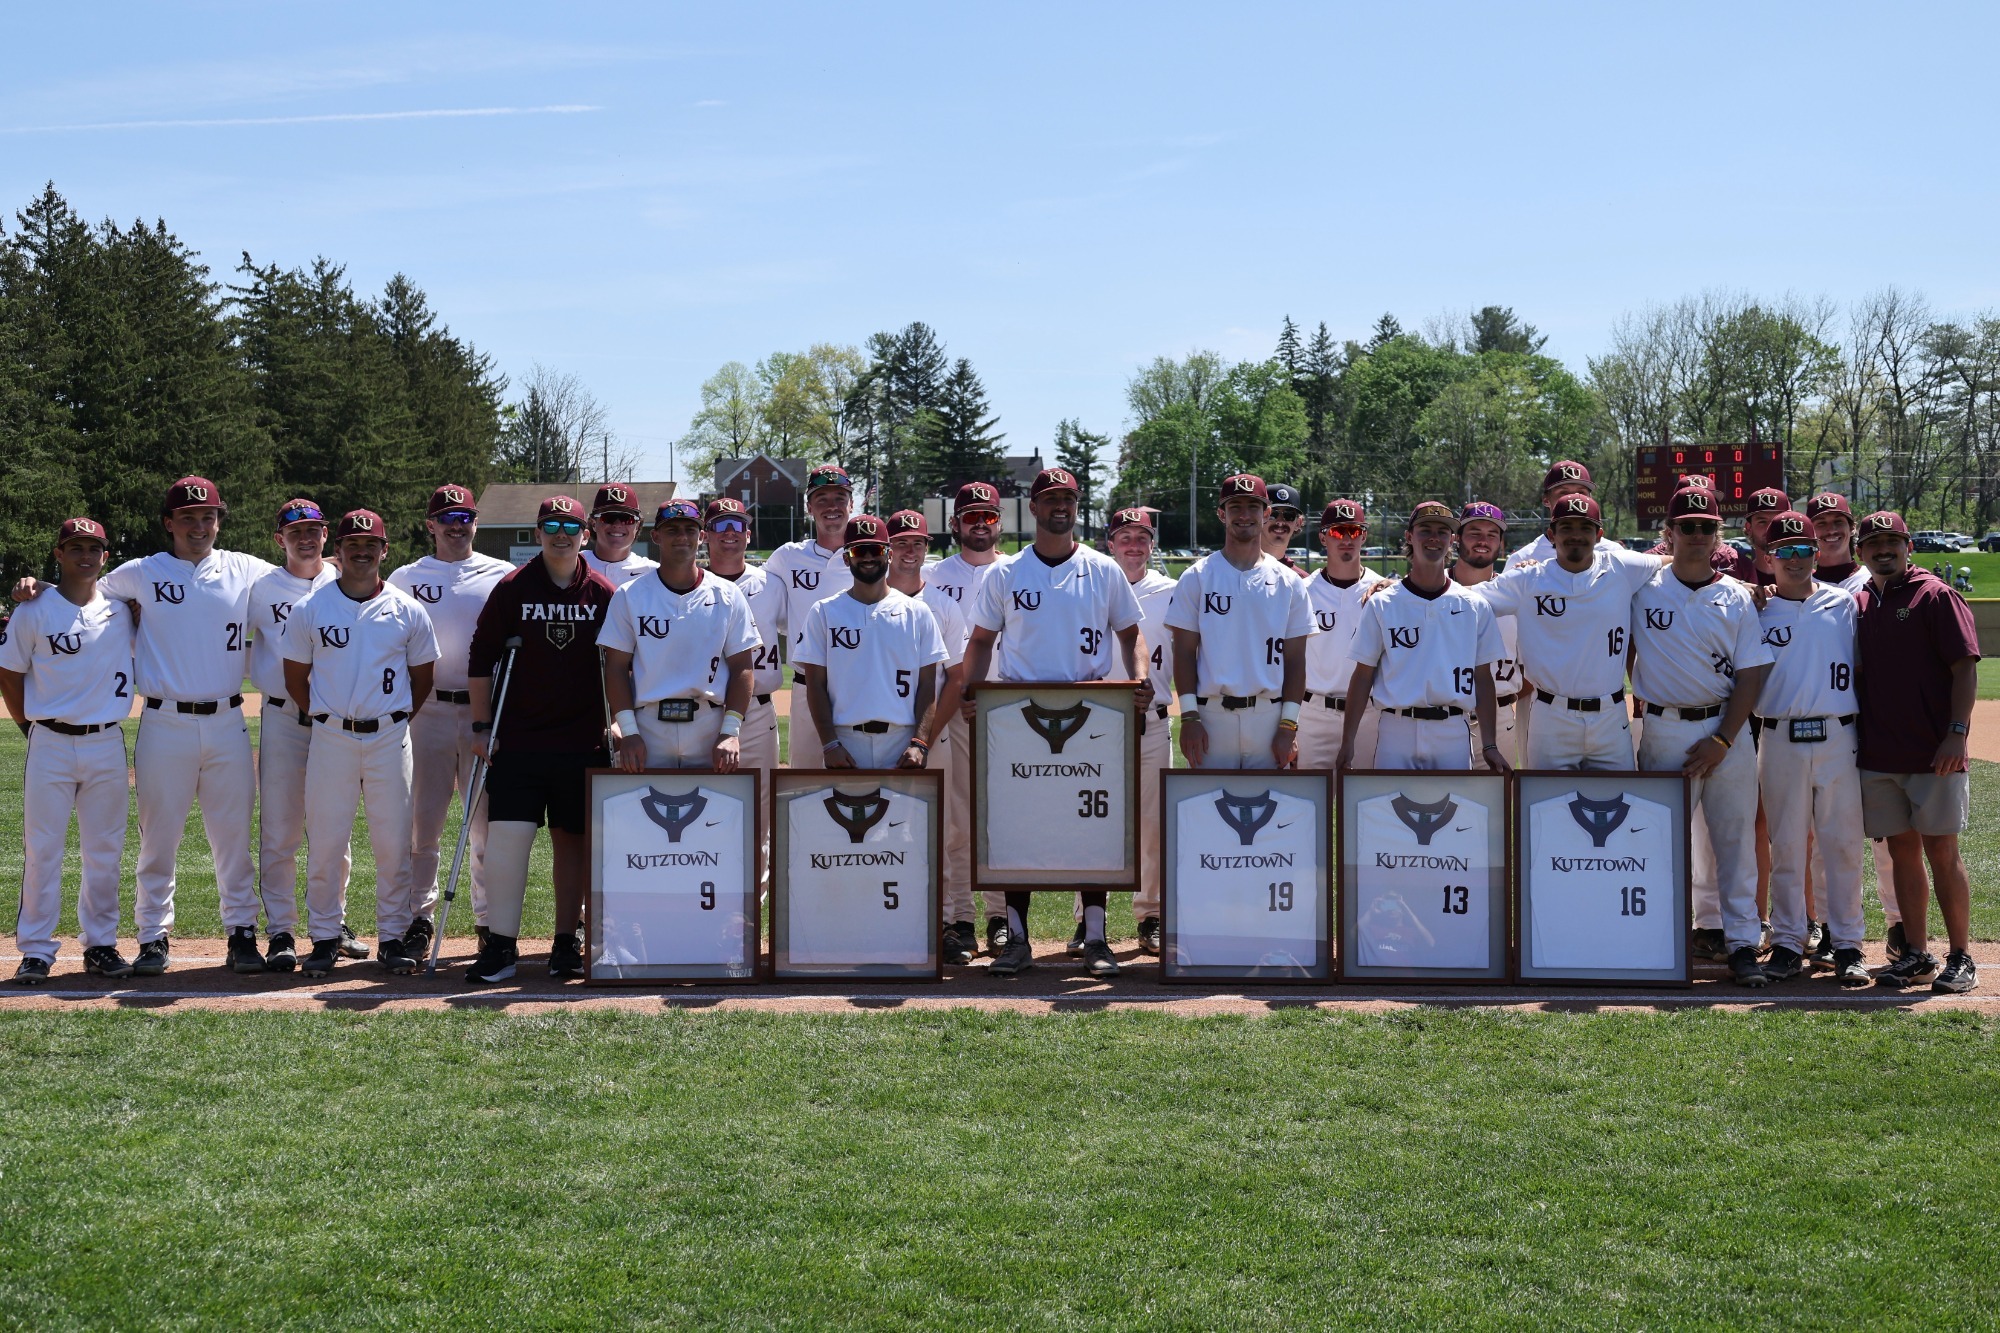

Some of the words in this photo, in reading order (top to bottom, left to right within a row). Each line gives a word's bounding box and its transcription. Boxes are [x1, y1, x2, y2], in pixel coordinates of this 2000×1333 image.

[1676, 453, 1683, 463] 0
[1705, 452, 1712, 462] 0
[1735, 450, 1742, 461] 0
[1048, 470, 1069, 484] KU
[1560, 466, 1581, 480] KU
[1736, 472, 1742, 483] 0
[1234, 478, 1256, 492] KU
[1687, 477, 1708, 488] KU
[184, 485, 208, 500] KU
[443, 490, 464, 504] KU
[606, 488, 628, 502] KU
[971, 488, 992, 501] KU
[1736, 488, 1742, 498] 0
[1757, 493, 1778, 506] KU
[551, 498, 572, 512] KU
[718, 500, 738, 512] KU
[1567, 498, 1589, 512] KU
[1686, 494, 1708, 510] KU
[1817, 496, 1838, 510] KU
[1121, 511, 1142, 522] KU
[1335, 505, 1355, 519] KU
[73, 520, 96, 534] KU
[352, 515, 374, 530] KU
[856, 520, 877, 536] KU
[900, 514, 920, 529] KU
[1781, 518, 1804, 534] KU
[1870, 516, 1894, 530] KU
[791, 570, 820, 590] KU
[152, 581, 186, 604] KU
[411, 584, 444, 604] KU
[936, 585, 964, 603] U
[1012, 589, 1042, 611] KU
[521, 604, 598, 621] FAMILY
[1204, 592, 1232, 616] KU
[1535, 594, 1566, 617] KU
[638, 616, 670, 639] KU
[1644, 608, 1675, 630] KU
[46, 632, 82, 655] KU
[226, 622, 242, 651] 21
[318, 625, 350, 648] KU
[830, 627, 861, 650] KU
[1388, 627, 1420, 649] KU
[1608, 626, 1624, 657] 16
[754, 644, 779, 670] 24
[114, 672, 128, 697] 2
[382, 668, 396, 694] 8
[896, 670, 911, 698] 5
[1452, 666, 1473, 695] 13
[1830, 662, 1850, 691] 18
[1011, 762, 1102, 779] KUTZTOWN
[1078, 790, 1108, 818] 36
[626, 850, 719, 870] KUTZTOWN
[810, 850, 904, 870] KUTZTOWN
[1200, 853, 1293, 870] KUTZTOWN
[1375, 852, 1468, 872] KUTZTOWN
[1551, 856, 1646, 872] KUTZTOWN
[700, 882, 715, 910] 9
[883, 882, 899, 910] 5
[1268, 882, 1294, 911] 19
[1442, 885, 1468, 914] 13
[1621, 886, 1646, 916] 16
